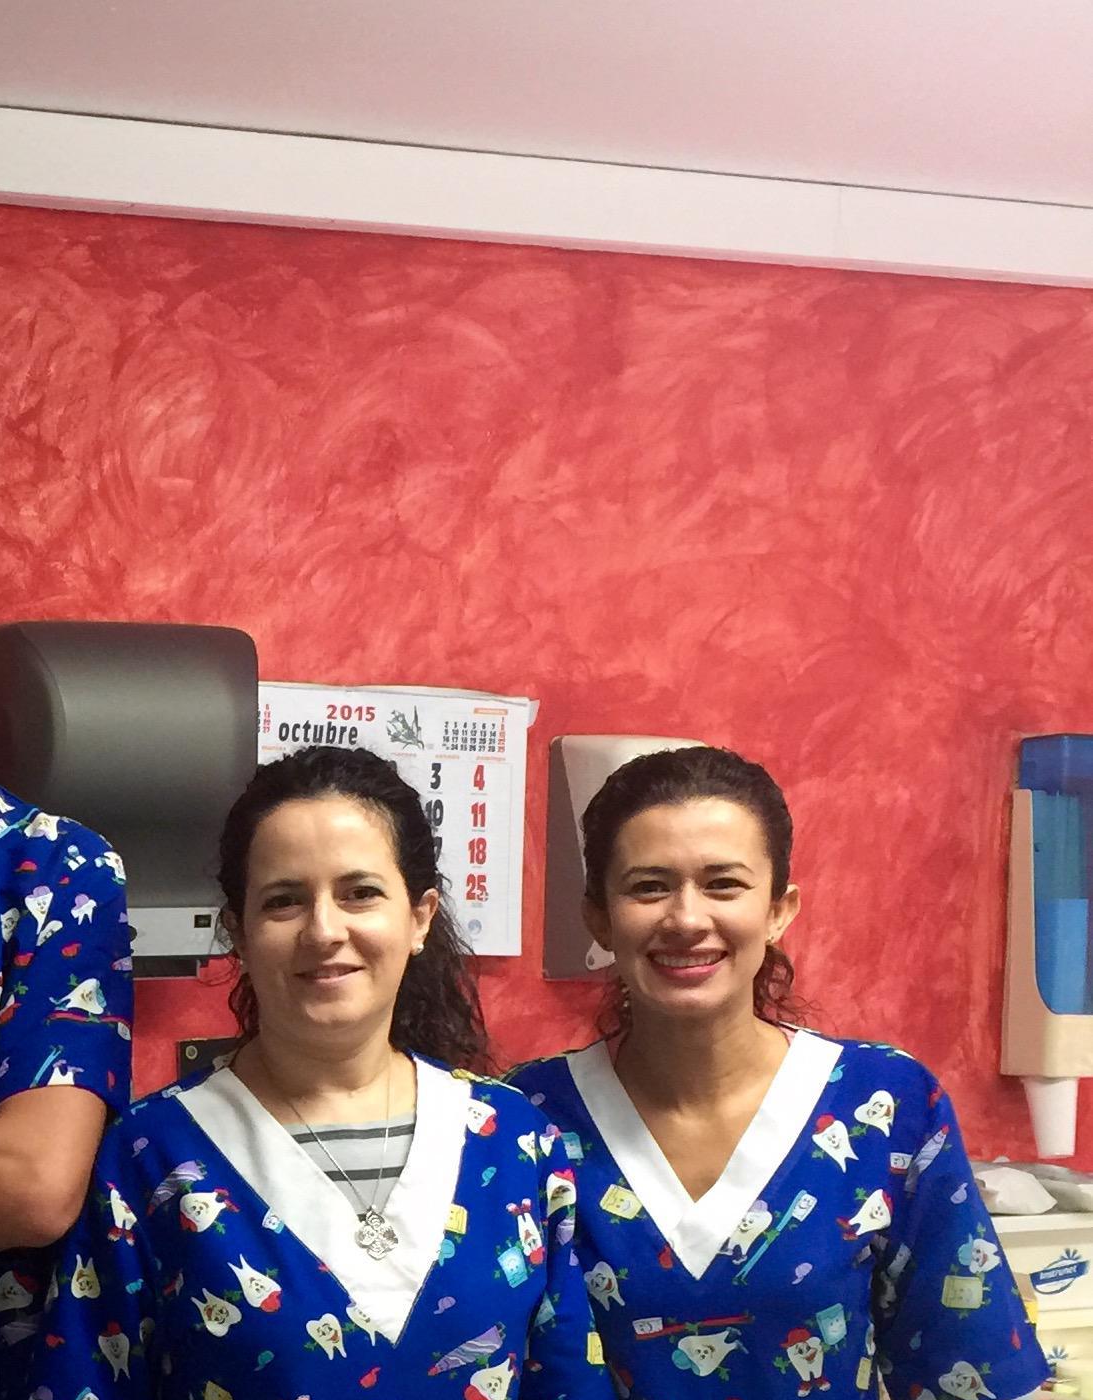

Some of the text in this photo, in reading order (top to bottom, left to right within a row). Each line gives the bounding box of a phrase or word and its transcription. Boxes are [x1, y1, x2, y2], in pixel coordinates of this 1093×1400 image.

[326, 704, 376, 722] 2015
[278, 720, 358, 745] octubre
[430, 763, 486, 791] 3 4
[425, 799, 486, 828] 10 11
[433, 836, 487, 865] 7 18
[465, 873, 487, 901] 25
